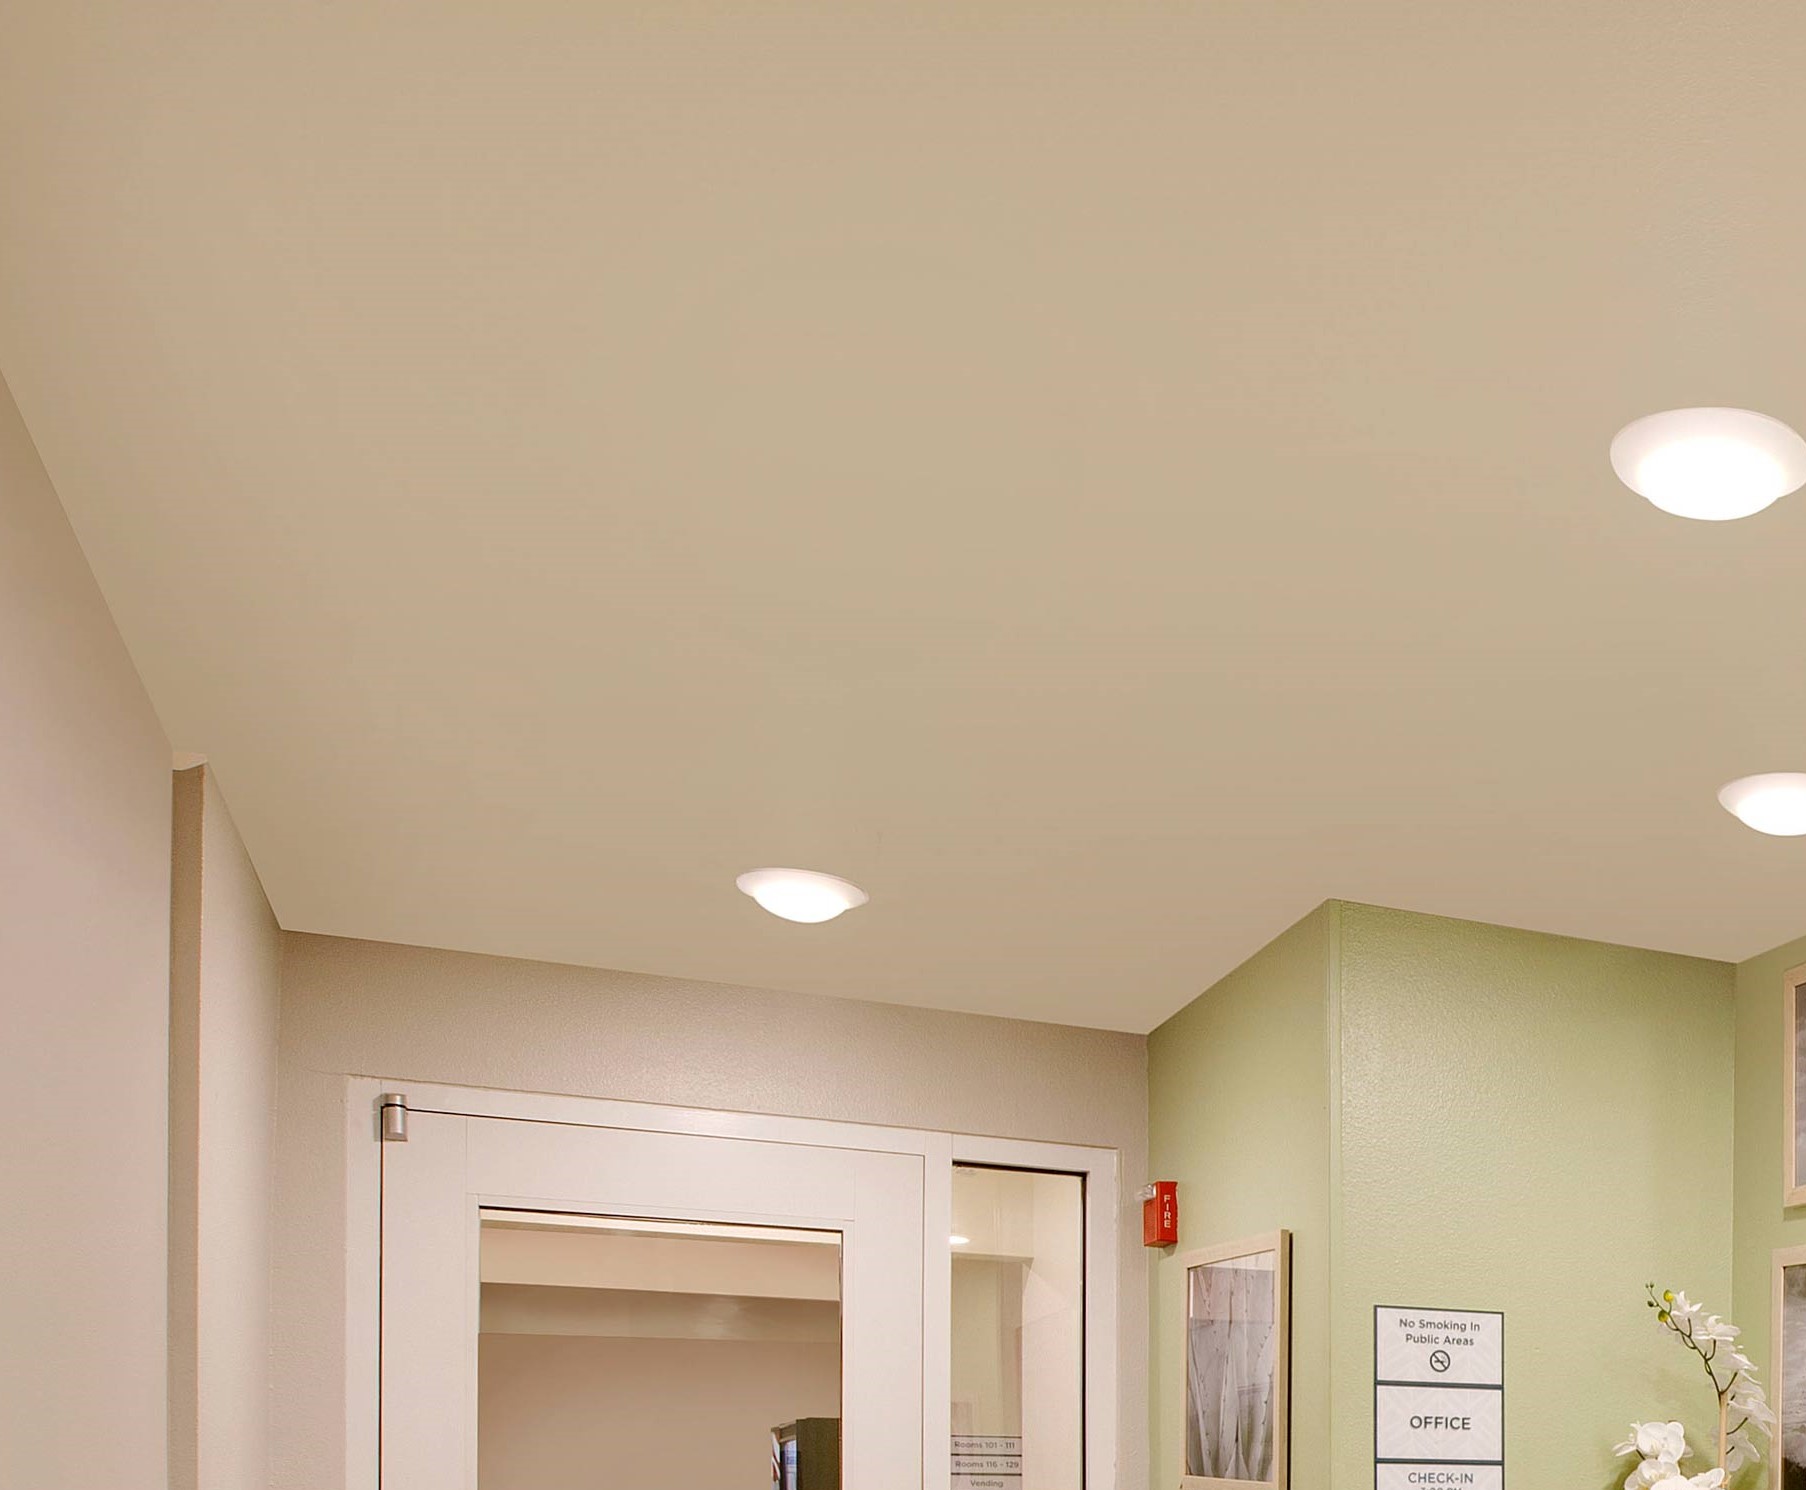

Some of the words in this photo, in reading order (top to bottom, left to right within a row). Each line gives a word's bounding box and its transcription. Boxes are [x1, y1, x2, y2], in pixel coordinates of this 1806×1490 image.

[1163, 1194, 1172, 1228] FIRE
[1399, 1318, 1416, 1329] No
[1418, 1319, 1467, 1332] Smoking
[1470, 1321, 1481, 1332] In
[1405, 1333, 1440, 1345] Public
[1443, 1335, 1475, 1346] Areas
[1409, 1415, 1472, 1430] OFFICE
[954, 1441, 983, 1449] Rooms
[985, 1441, 998, 1449] 101
[970, 1480, 1004, 1488] Vending
[1407, 1472, 1474, 1484] CHECK-IN
